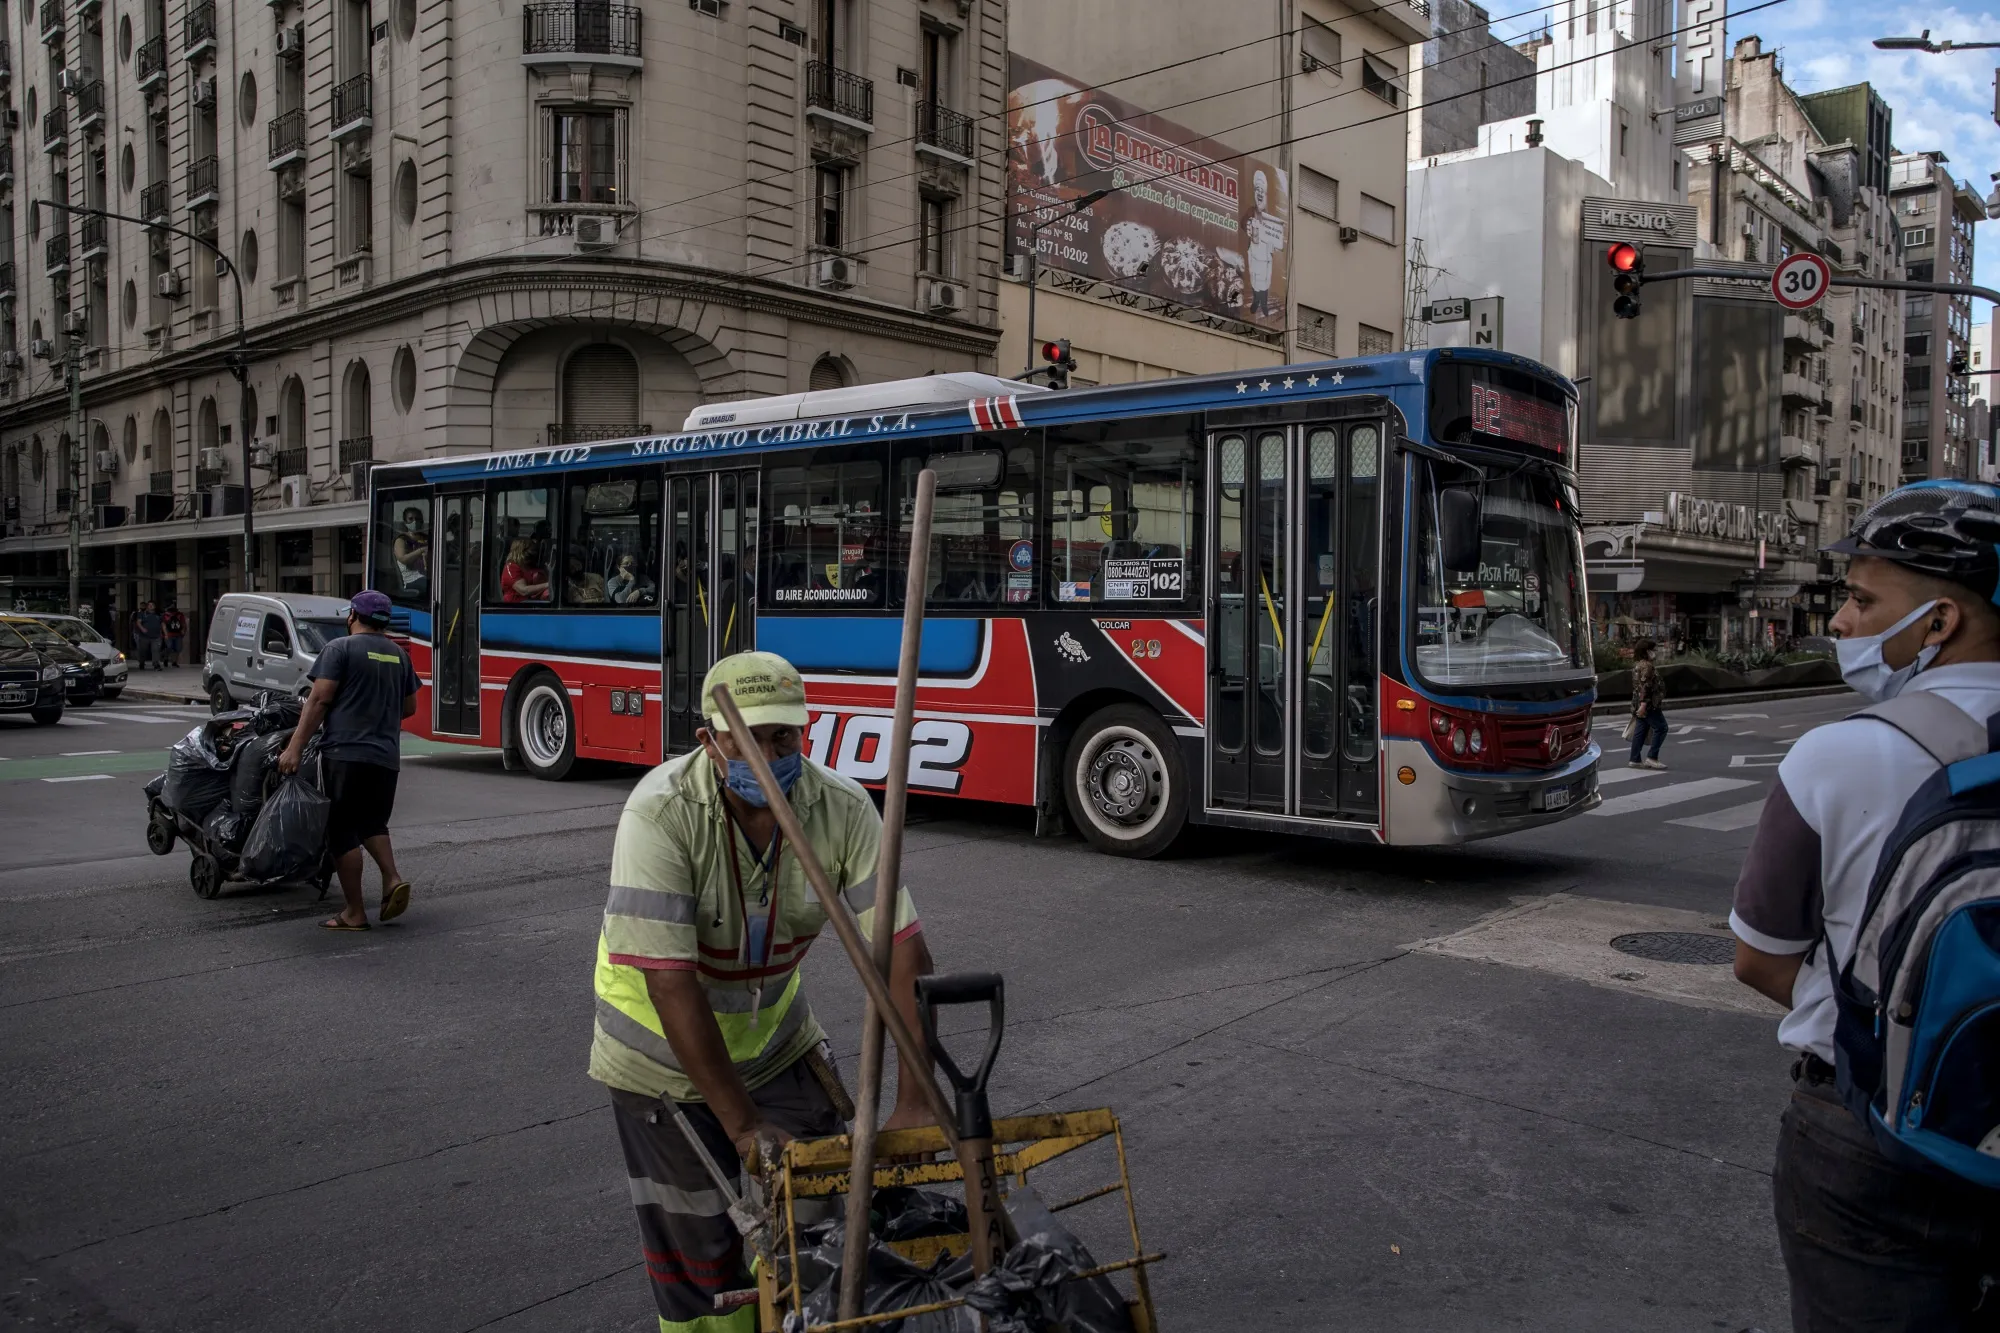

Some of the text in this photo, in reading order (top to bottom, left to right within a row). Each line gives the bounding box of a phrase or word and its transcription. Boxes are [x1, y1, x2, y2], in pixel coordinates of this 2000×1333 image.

[1676, 103, 1705, 118] sura
[1114, 131, 1239, 201] AMERICANA
[1164, 190, 1176, 210] de
[1176, 194, 1191, 214] las
[1191, 204, 1239, 232] empanadas
[1016, 218, 1028, 229] Av.
[1064, 231, 1073, 242] 83
[1784, 268, 1816, 294] 30
[1433, 305, 1463, 317] LOS
[1475, 312, 1493, 350] IN
[701, 413, 736, 426] CLIMABUS
[484, 412, 917, 472] LINEA 102 SARGENTO CABRAL S.A.
[1665, 491, 1757, 540] METROPOLITAN
[842, 547, 864, 558] Uruguay
[1133, 585, 1147, 598] 29
[1151, 572, 1181, 591] 102
[785, 588, 868, 600] AIRE ACONDICIONADO
[1131, 638, 1162, 660] 29
[734, 675, 777, 696] HIGIENE URBANA
[807, 712, 973, 794] 102
